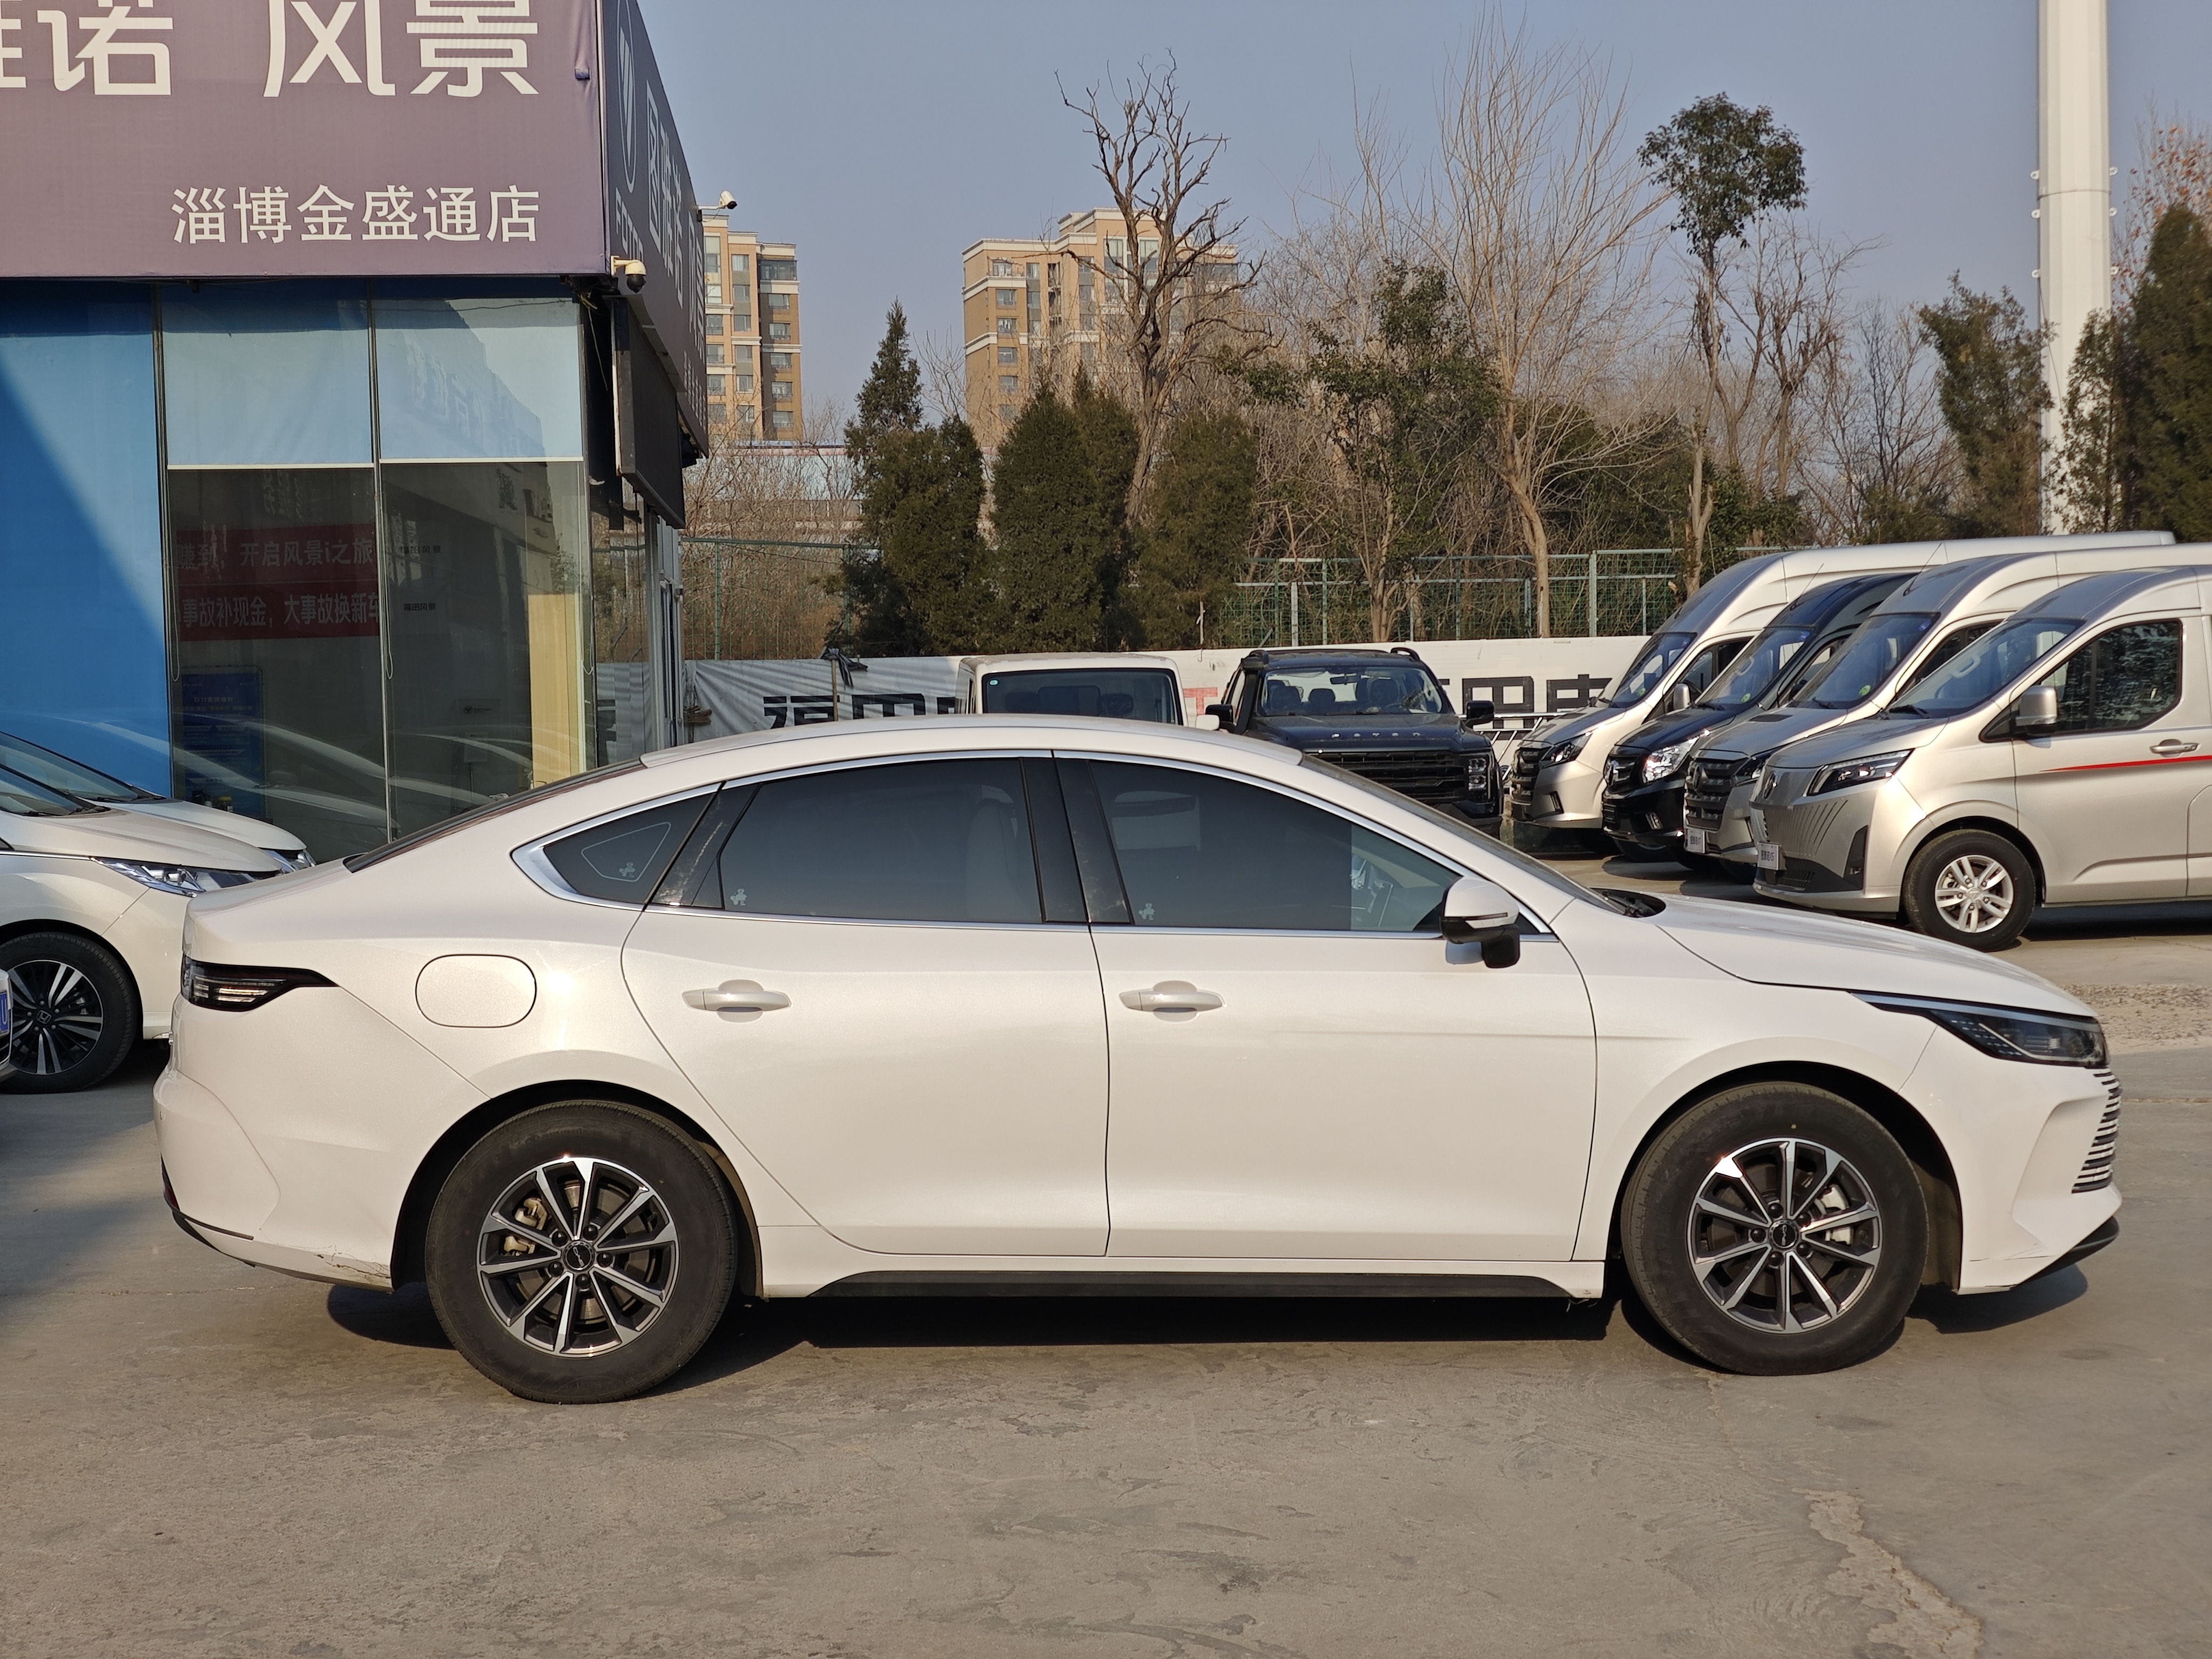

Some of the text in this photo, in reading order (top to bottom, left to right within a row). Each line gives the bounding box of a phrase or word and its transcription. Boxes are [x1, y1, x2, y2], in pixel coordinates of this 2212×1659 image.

[0, 0, 539, 98] 诺 风景
[171, 184, 540, 245] 淄博金盛通店
[646, 79, 705, 366] 图雅诺 风景
